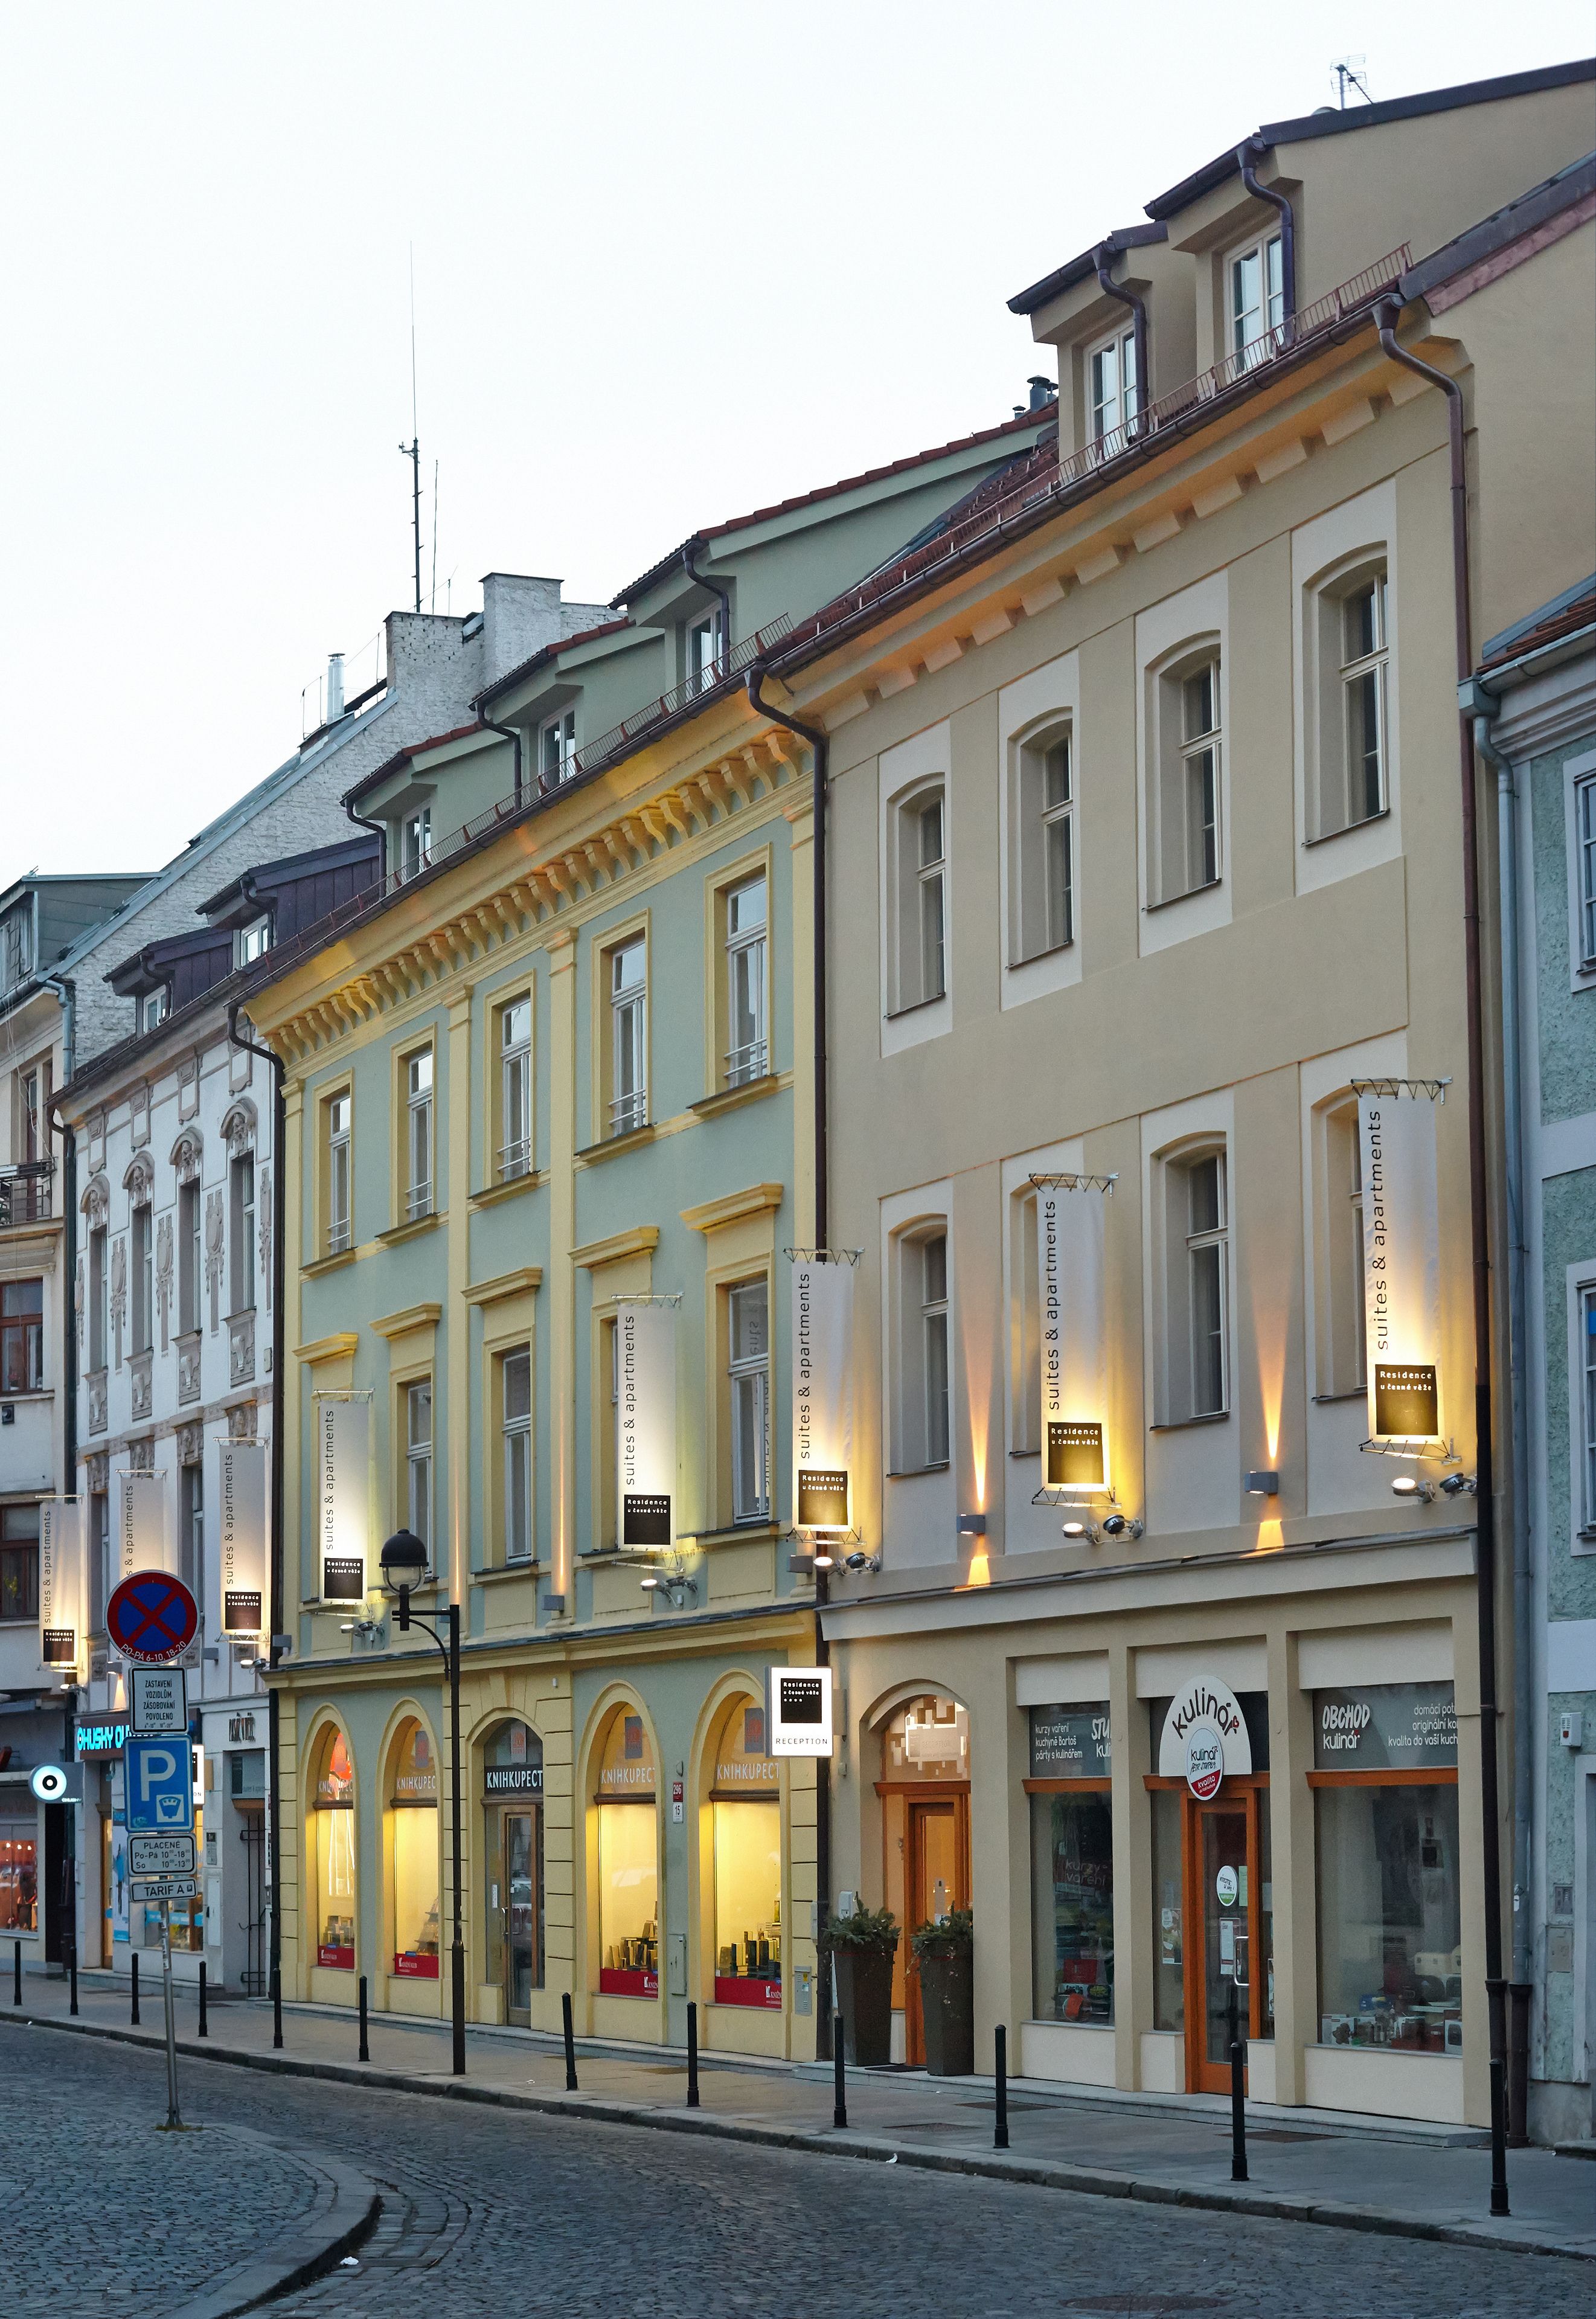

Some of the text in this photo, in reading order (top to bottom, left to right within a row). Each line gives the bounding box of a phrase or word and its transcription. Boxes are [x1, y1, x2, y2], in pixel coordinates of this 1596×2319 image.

[1368, 1111, 1388, 1350] suites & apartments
[1043, 1201, 1062, 1410] suites & apartments
[798, 1273, 813, 1459] suites & apartments
[624, 1315, 637, 1485] suites & apartments
[324, 1410, 336, 1489] apartments
[225, 1454, 235, 1528] apartments
[125, 1486, 135, 1553] apartments
[324, 1509, 333, 1550] suites
[225, 1547, 233, 1584] suites
[121, 1644, 144, 1661] PO-PÁ
[167, 1641, 187, 1658] 18-20
[145, 1678, 172, 1688] ZASTAVENÍ
[146, 1689, 172, 1699] VOZIDLŮM
[1322, 1704, 1370, 1730] OBCHOD
[1414, 1703, 1440, 1715] domácí
[1035, 1722, 1069, 1736] kurzy vaření
[1091, 1717, 1111, 1740] STU
[1412, 1718, 1458, 1733] originální ko
[1035, 1735, 1077, 1749] kuchyně Bartoš
[1388, 1735, 1412, 1746] kvalita
[1413, 1734, 1423, 1746] do
[1425, 1733, 1440, 1745] vaší
[1036, 1750, 1050, 1762] párty
[1056, 1748, 1083, 1759] kulinářem
[140, 1750, 176, 1801] P
[487, 1770, 543, 1788] KNIHKUPECT
[717, 1763, 780, 1780] KNIHKUPECT
[1197, 1775, 1216, 1789] kvalita
[675, 1805, 680, 1815] 15
[144, 1841, 180, 1849] PLACENÉ
[144, 1884, 184, 1896] TARIF A
